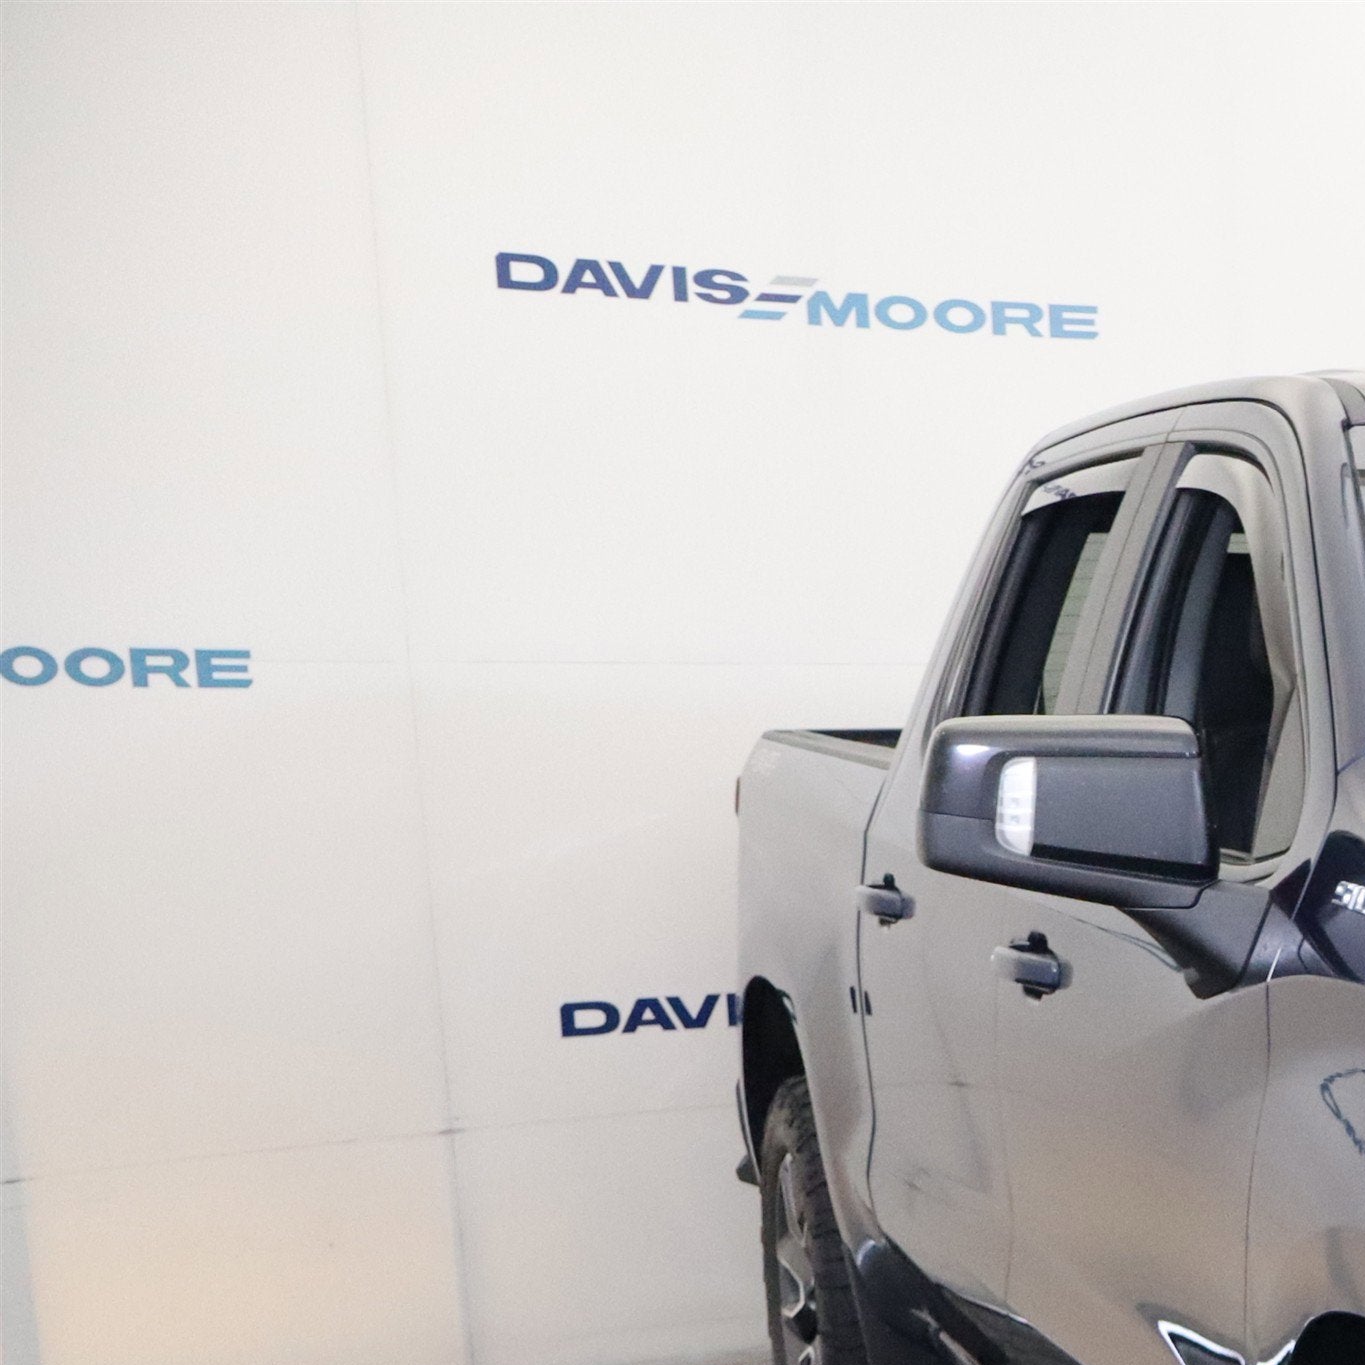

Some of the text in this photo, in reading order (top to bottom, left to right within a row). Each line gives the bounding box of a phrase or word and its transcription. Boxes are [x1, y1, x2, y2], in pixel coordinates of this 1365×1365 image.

[495, 252, 1099, 340] DAVIS MOORE
[0, 646, 253, 688] OORE
[560, 993, 743, 1037] DAVI
